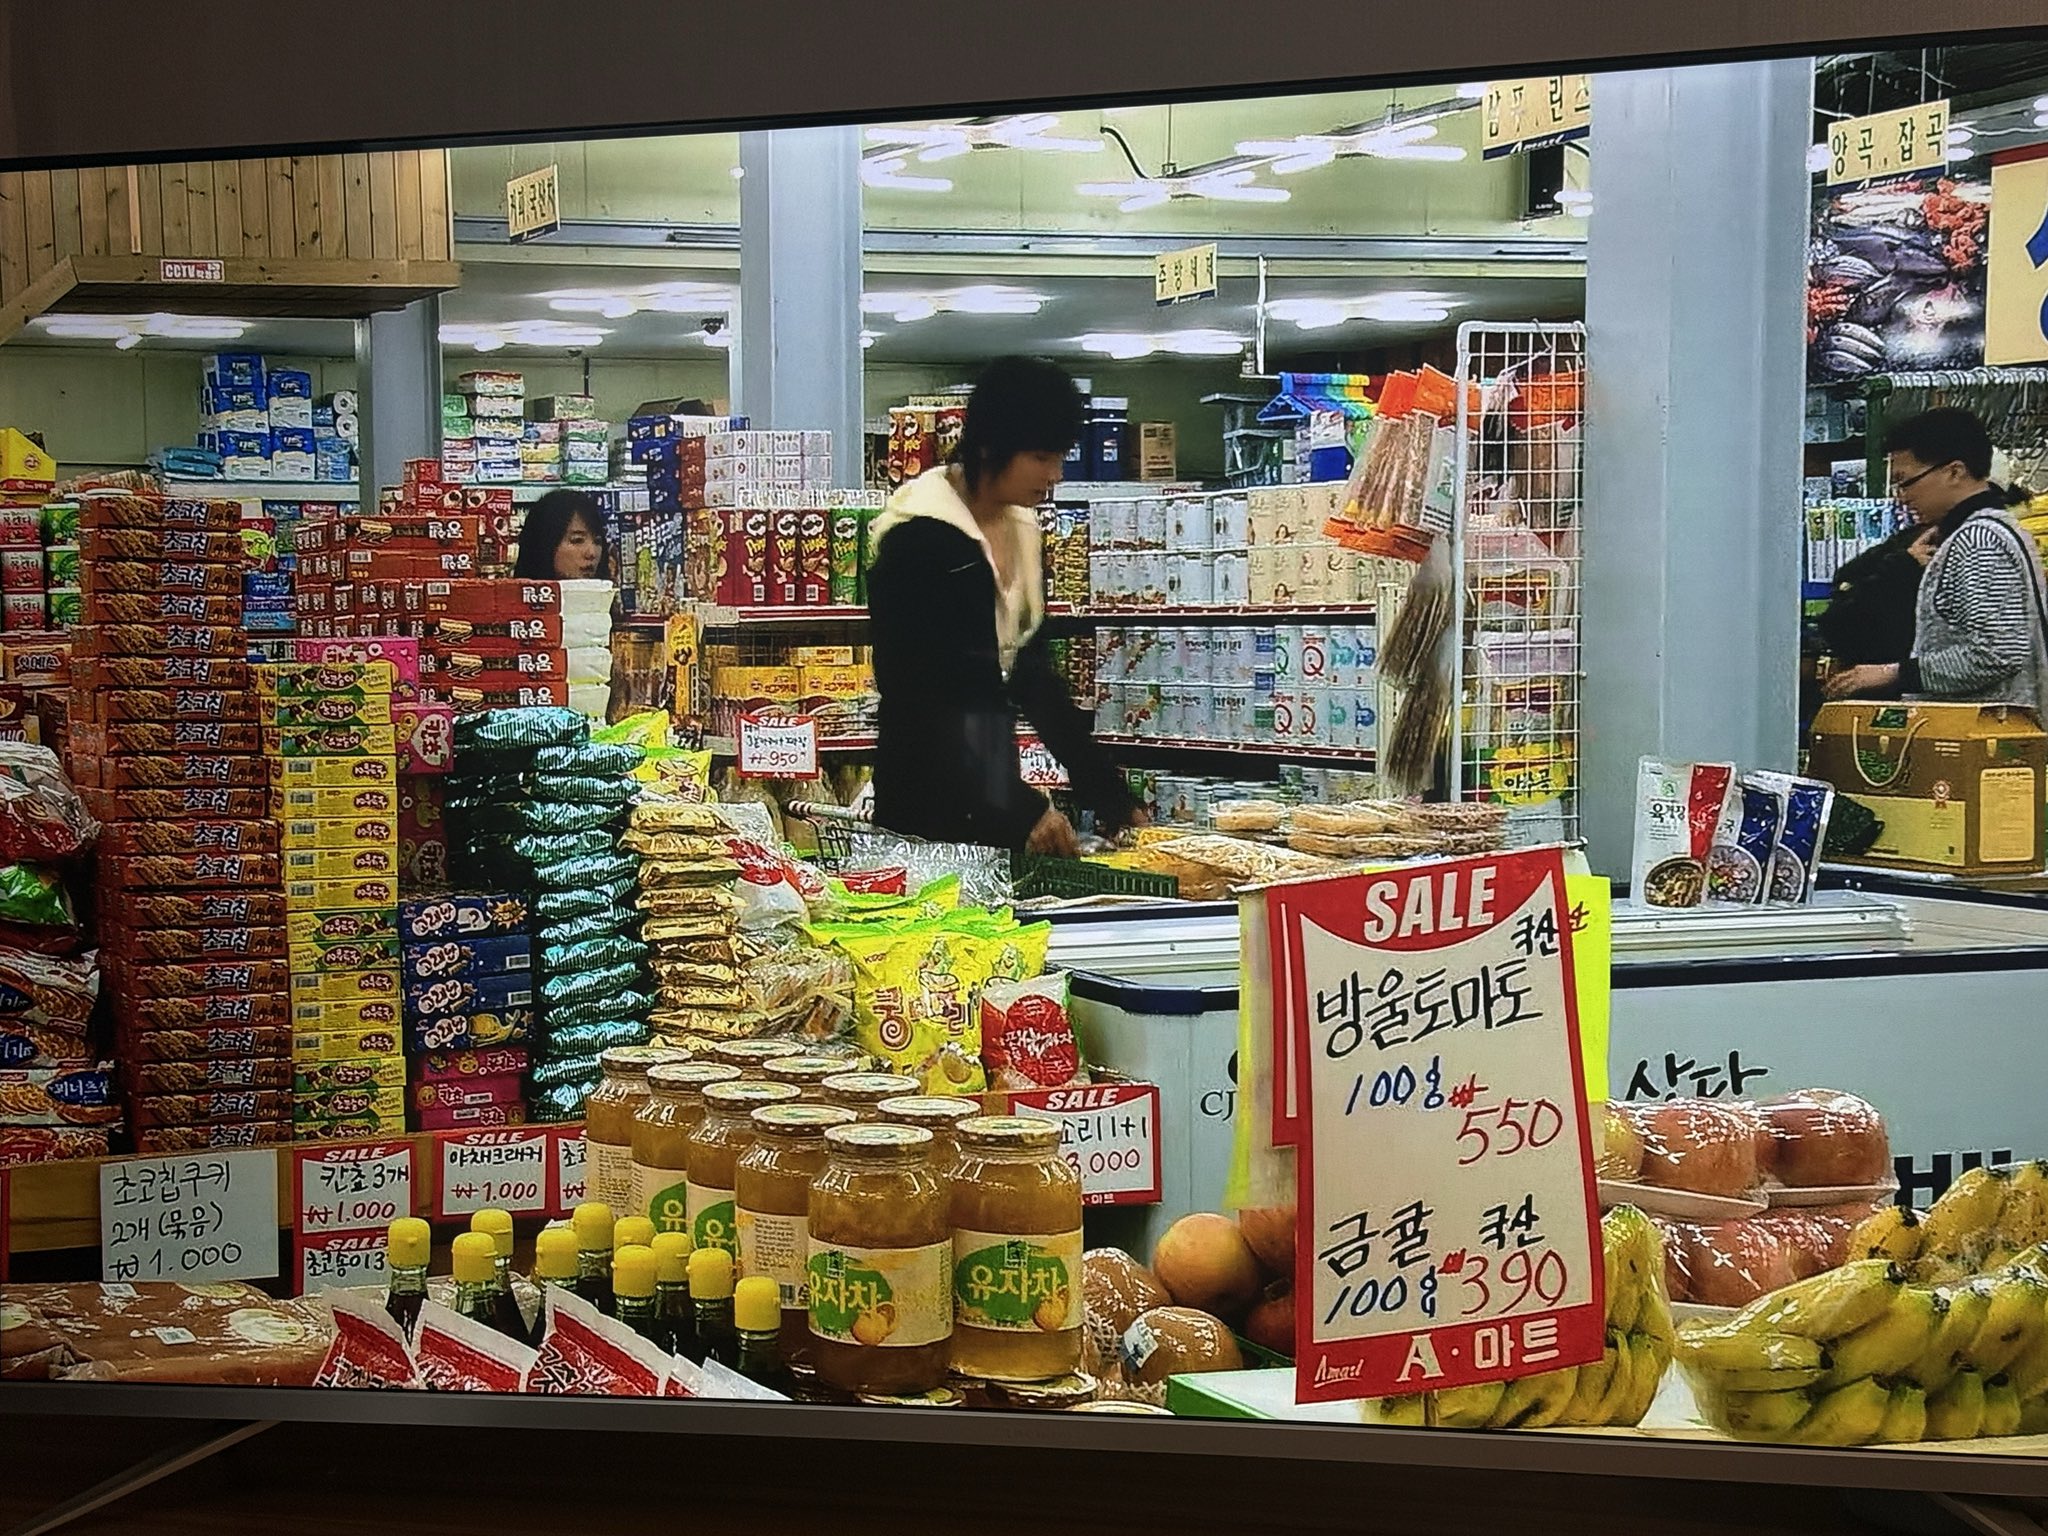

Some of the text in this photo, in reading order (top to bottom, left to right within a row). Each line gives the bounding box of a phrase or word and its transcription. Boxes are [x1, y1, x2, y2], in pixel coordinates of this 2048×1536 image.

[1896, 112, 1943, 162] 잡곡
[165, 264, 196, 278] CCTV
[164, 499, 209, 526] 초코칩
[163, 530, 209, 557] 초코칩
[161, 560, 209, 590] 초코칩
[161, 593, 208, 622] 초코칩
[167, 625, 214, 652] 초코칩
[165, 655, 211, 684] 초코칩
[177, 690, 225, 717] 초코칩
[175, 722, 225, 749] 초코칩
[758, 716, 799, 727] SALE
[184, 755, 232, 783] 초코칩
[183, 786, 232, 814] 초코칩
[194, 822, 242, 850] 초코칩
[196, 854, 244, 882] 초코칩
[202, 896, 250, 923] 초코칩
[1363, 865, 1498, 943] SALE
[203, 926, 250, 954] 초코칩
[205, 964, 254, 992] 초코칩
[205, 995, 254, 1023] 초코칩
[1316, 958, 1544, 1059] 방울토마토
[207, 1027, 257, 1054] 초코칩
[210, 1091, 259, 1118] 초코칩
[1046, 1087, 1120, 1111] SALE
[1200, 1089, 1237, 1122] CJ
[209, 1124, 260, 1148] 초코칩
[464, 1130, 525, 1146] SALE
[323, 1146, 387, 1164] SALE
[449, 1143, 543, 1168] 야채크래커
[111, 1159, 232, 1207] 초코칩쿠키
[111, 1200, 224, 1244] 2개 (묶음)
[967, 1264, 1063, 1304] 유자차
